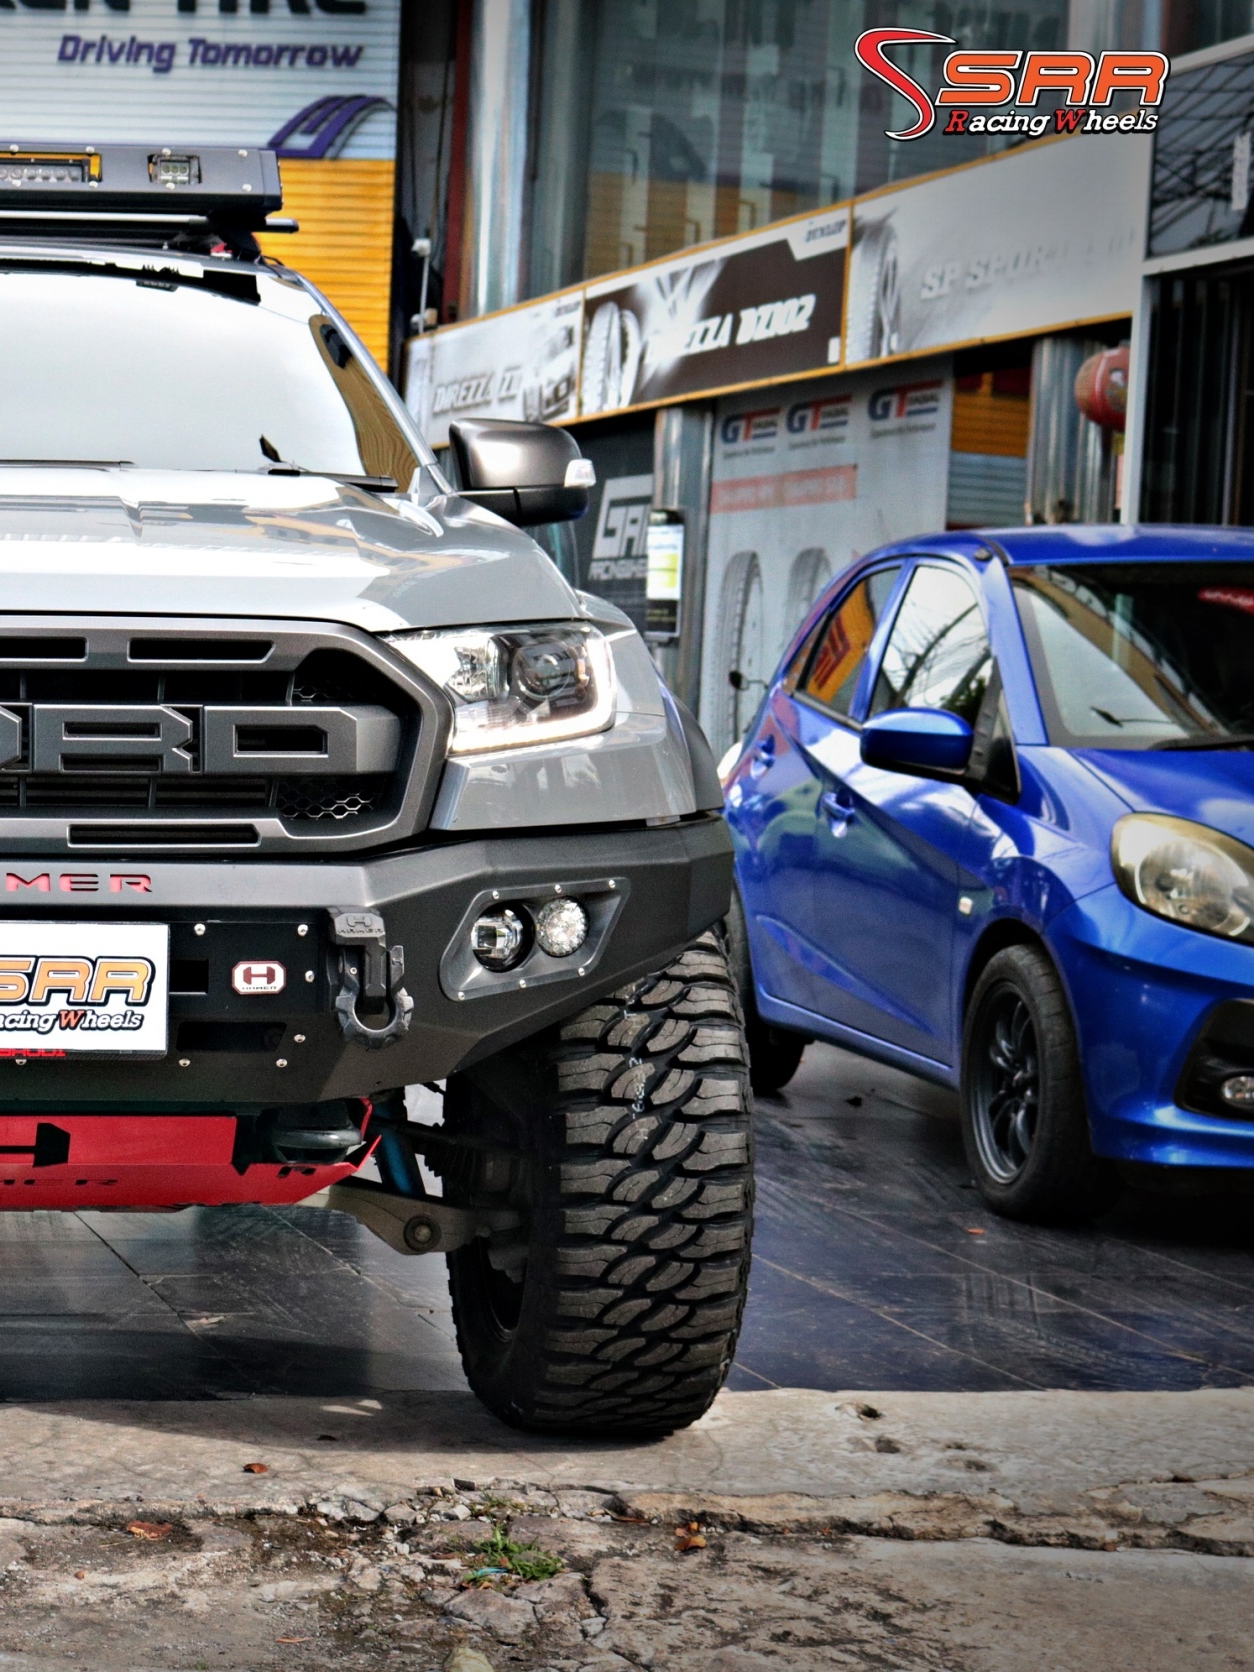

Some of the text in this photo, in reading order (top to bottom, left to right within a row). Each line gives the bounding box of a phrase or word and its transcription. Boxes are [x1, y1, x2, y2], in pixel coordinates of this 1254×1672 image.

[57, 35, 365, 73] Driving Tomorrow
[58, 1009, 145, 1032] Wheels
